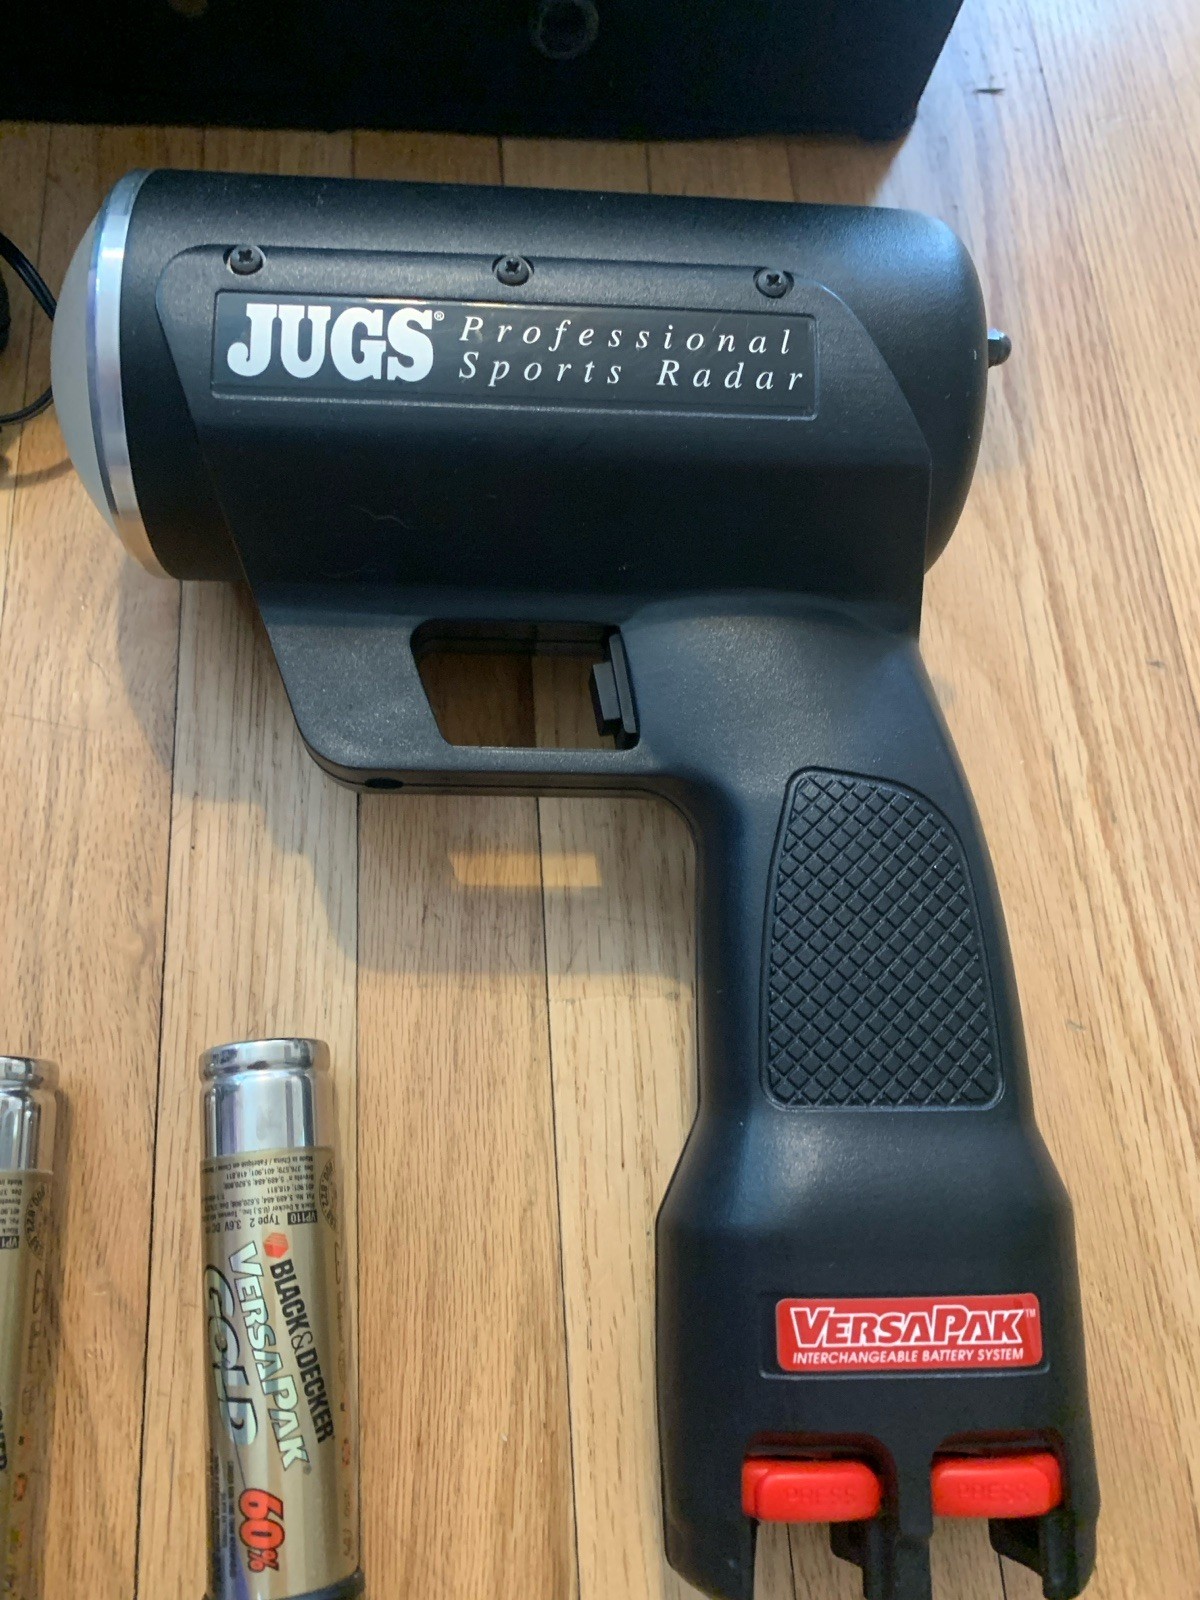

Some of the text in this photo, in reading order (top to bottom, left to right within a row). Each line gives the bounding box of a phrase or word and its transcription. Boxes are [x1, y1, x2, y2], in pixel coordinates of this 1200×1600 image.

[226, 302, 793, 382] JUGS Professional
[459, 351, 803, 391] Sports Radar
[224, 1218, 242, 1231] 3.6V
[249, 1217, 256, 1228] 2
[257, 1214, 280, 1226] Type
[289, 1210, 318, 1225] VP110
[269, 1258, 335, 1444] BLACK&DECKER
[792, 1347, 1025, 1364] INTERCHANGEABLE BATTERY SYSTEM
[238, 1487, 286, 1574] 60%
